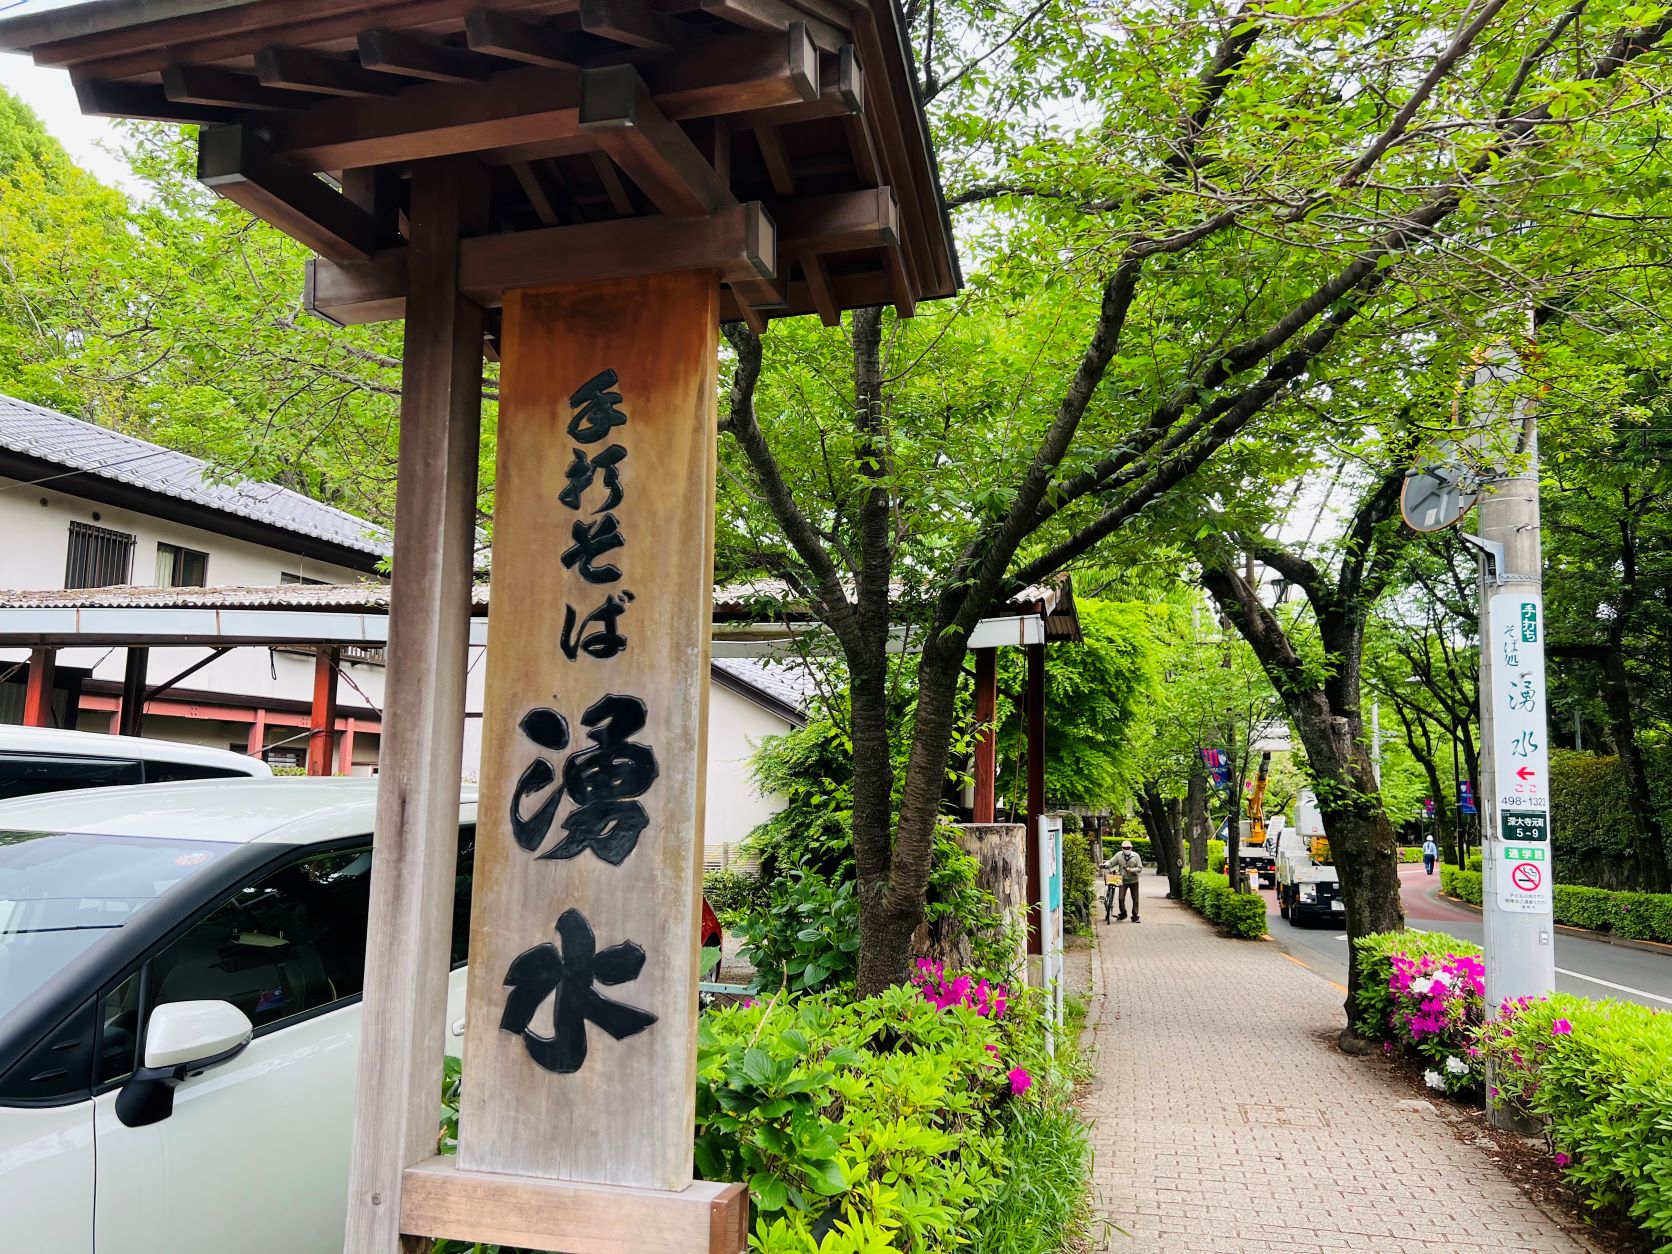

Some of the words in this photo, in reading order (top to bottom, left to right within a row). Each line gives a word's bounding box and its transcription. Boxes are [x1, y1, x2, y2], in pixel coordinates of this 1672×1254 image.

[1521, 604, 1536, 642] 手打ち
[1504, 624, 1519, 667] そば処
[1508, 681, 1539, 758] 湧水
[1515, 783, 1537, 793] ここ
[1507, 816, 1545, 827] 深大寺元町
[499, 692, 661, 1074] 湧水
